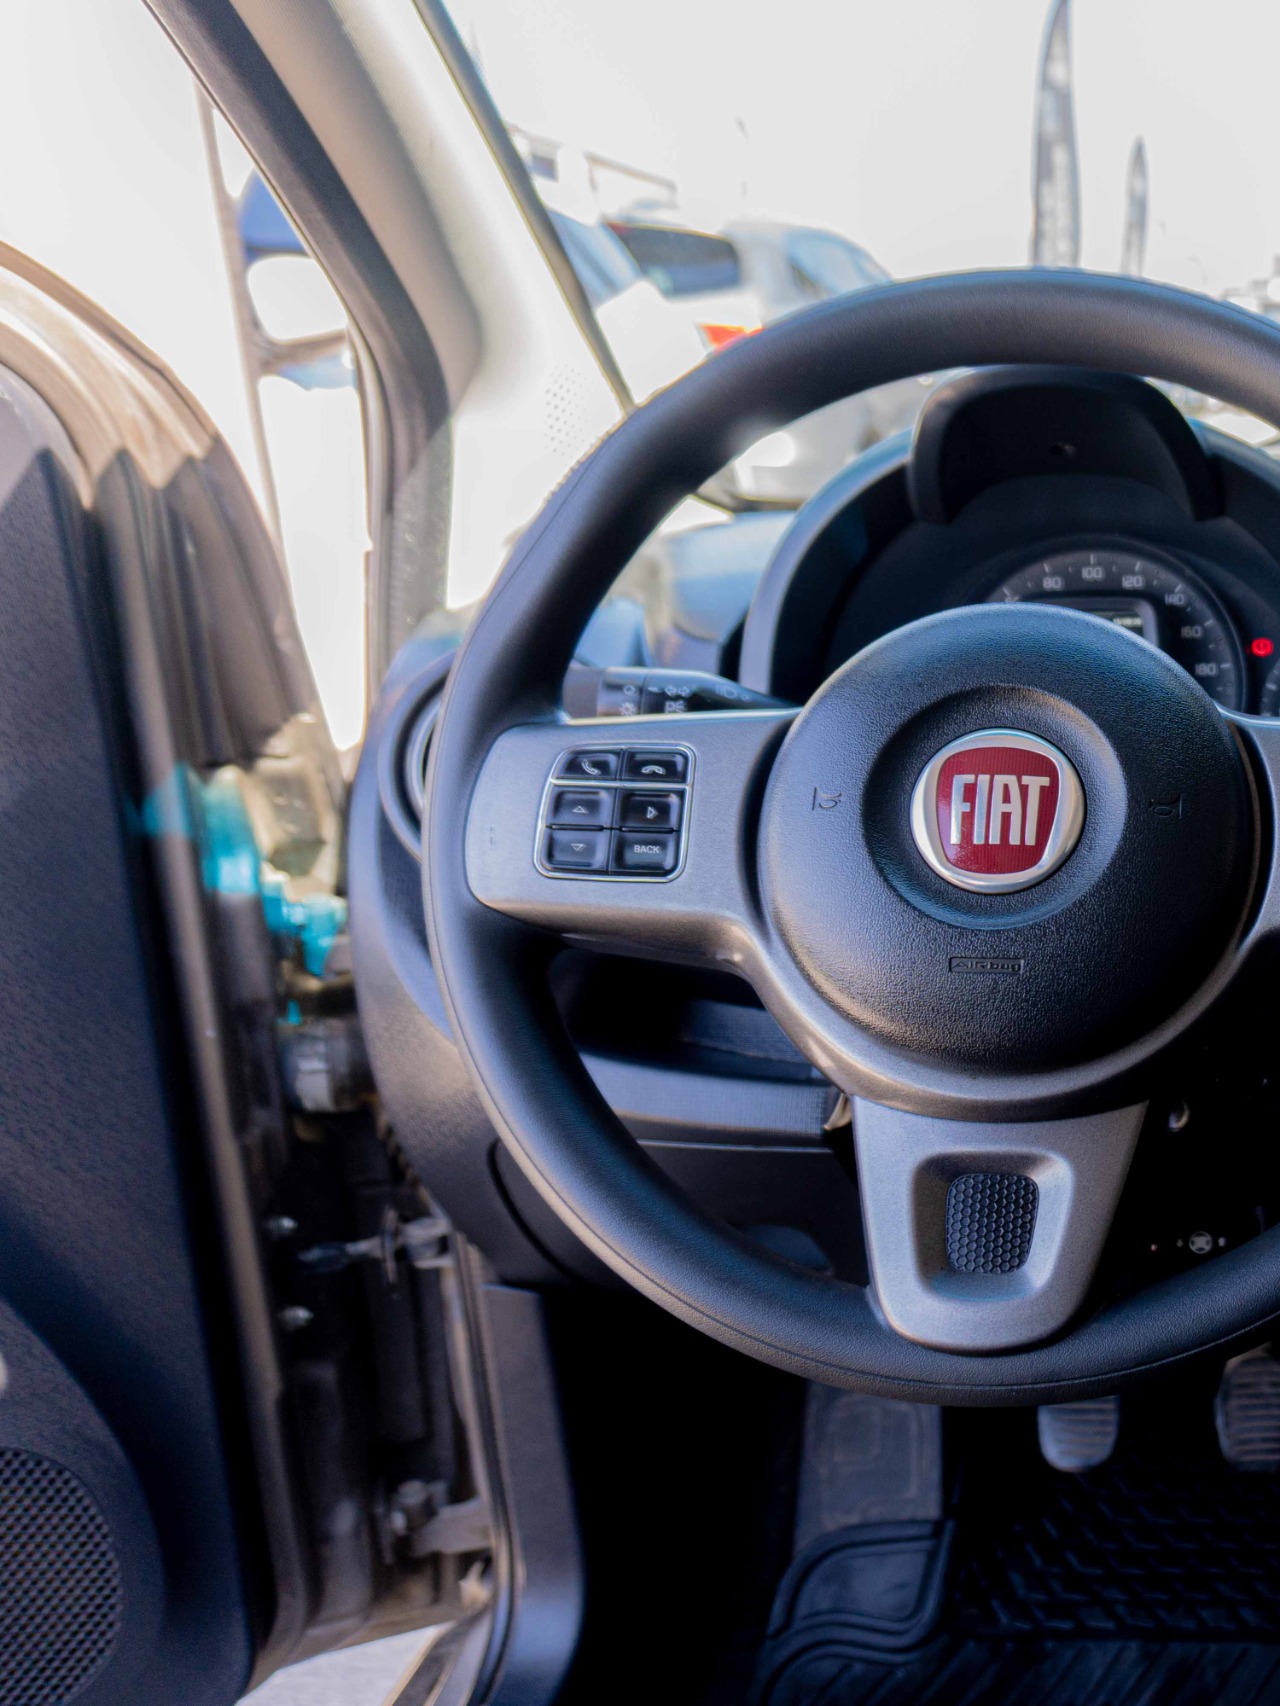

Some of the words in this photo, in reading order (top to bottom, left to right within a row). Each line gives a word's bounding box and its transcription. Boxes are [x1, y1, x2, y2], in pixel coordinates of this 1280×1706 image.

[1081, 567, 1102, 579] 100
[1043, 577, 1061, 589] 80
[1122, 576, 1142, 588] 120
[1165, 593, 1185, 605] 140
[1181, 626, 1202, 638] 160
[1195, 663, 1216, 676] 180
[950, 774, 1050, 846] FIAT
[634, 844, 660, 854] BACK
